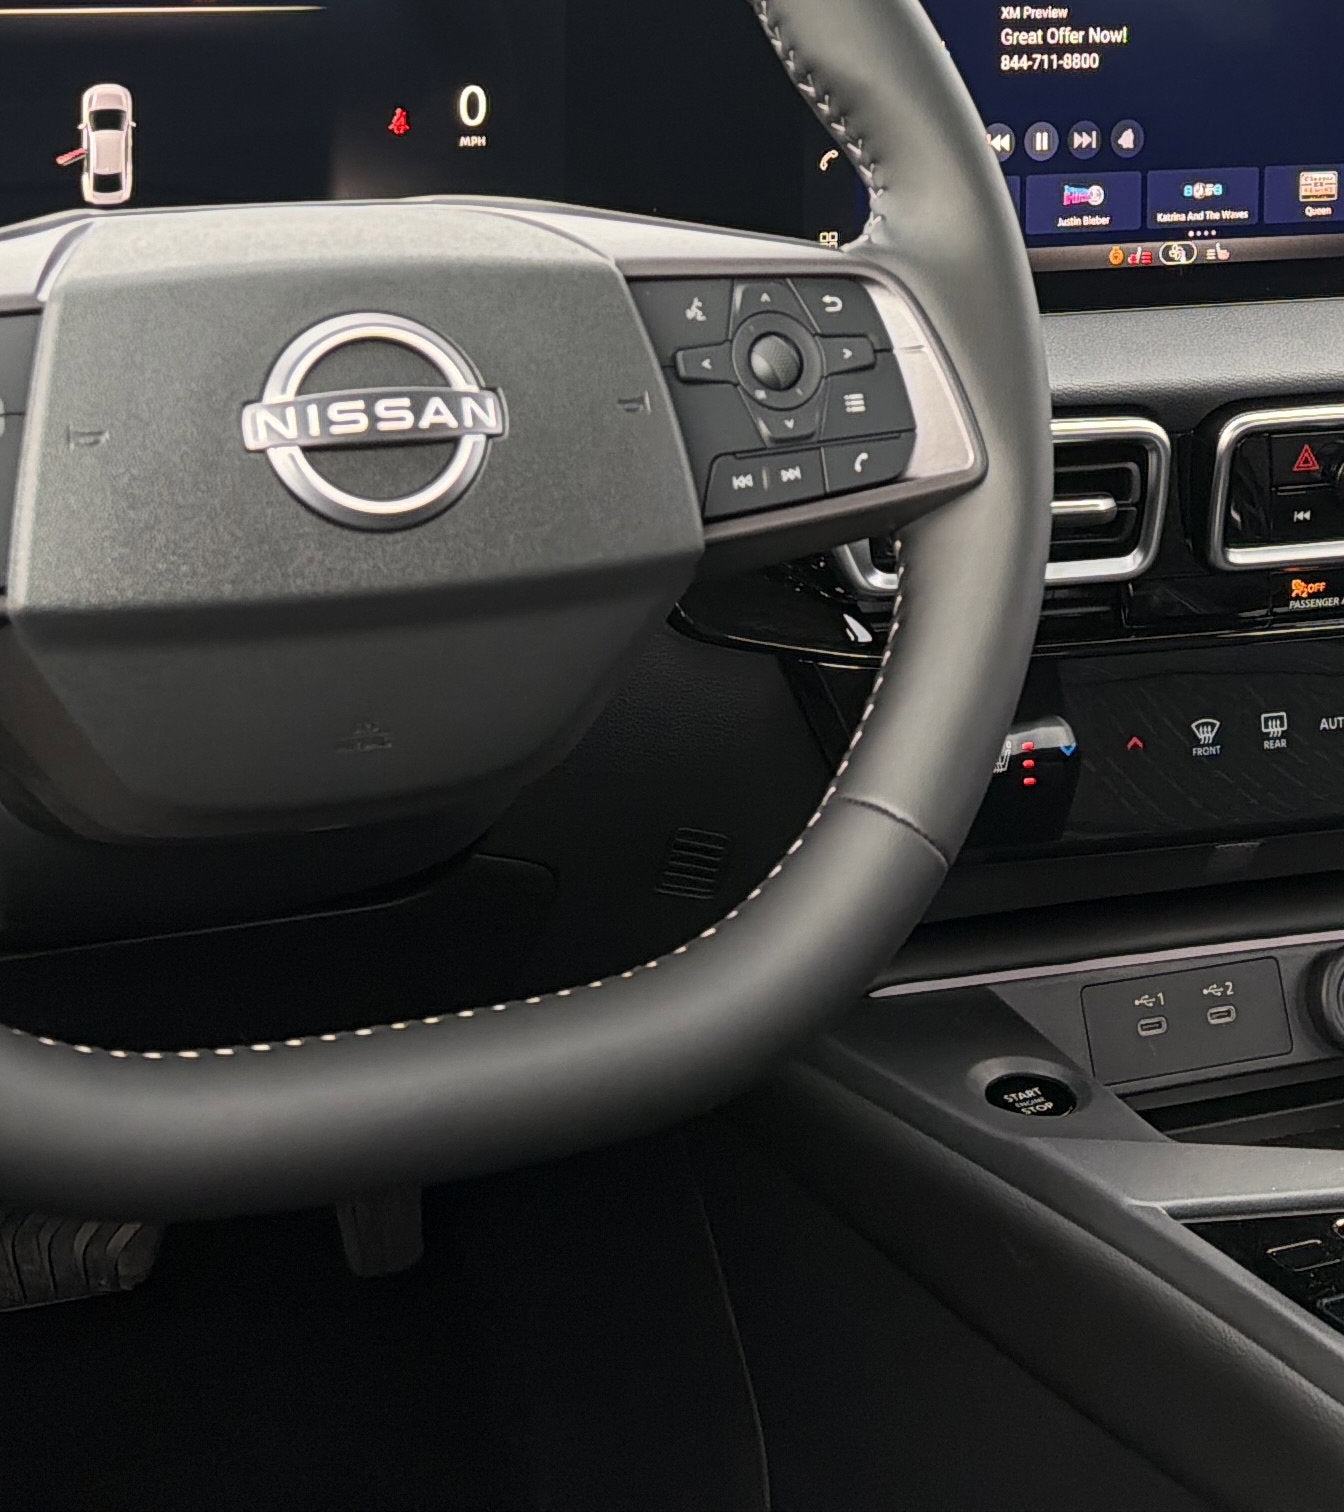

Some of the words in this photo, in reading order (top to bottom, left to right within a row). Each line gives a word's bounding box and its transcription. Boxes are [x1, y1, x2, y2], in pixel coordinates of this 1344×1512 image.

[1000, 6, 1021, 20] XM
[1023, 5, 1068, 19] Preview
[1000, 27, 1044, 45] Great
[1046, 27, 1085, 44] Offer
[1088, 26, 1128, 44] Now!
[1000, 53, 1100, 71] 844-711-8800
[459, 84, 487, 127] 0
[459, 135, 487, 147] MPH
[1157, 212, 1186, 223] Katrina
[1187, 211, 1204, 221] And
[1205, 210, 1220, 220] The
[1221, 209, 1249, 219] Waves
[1305, 206, 1332, 217] Queen
[1057, 216, 1082, 227] Justin
[254, 396, 498, 440] NISSAN
[1307, 581, 1326, 593] OFF
[1289, 596, 1339, 609] PASSENGER
[1192, 745, 1221, 756] FRONT
[1264, 739, 1287, 750] REAR
[1225, 981, 1234, 995] 2
[1157, 992, 1165, 1005] 1
[1003, 1087, 1042, 1103] START
[1021, 1102, 1054, 1115] STOP
